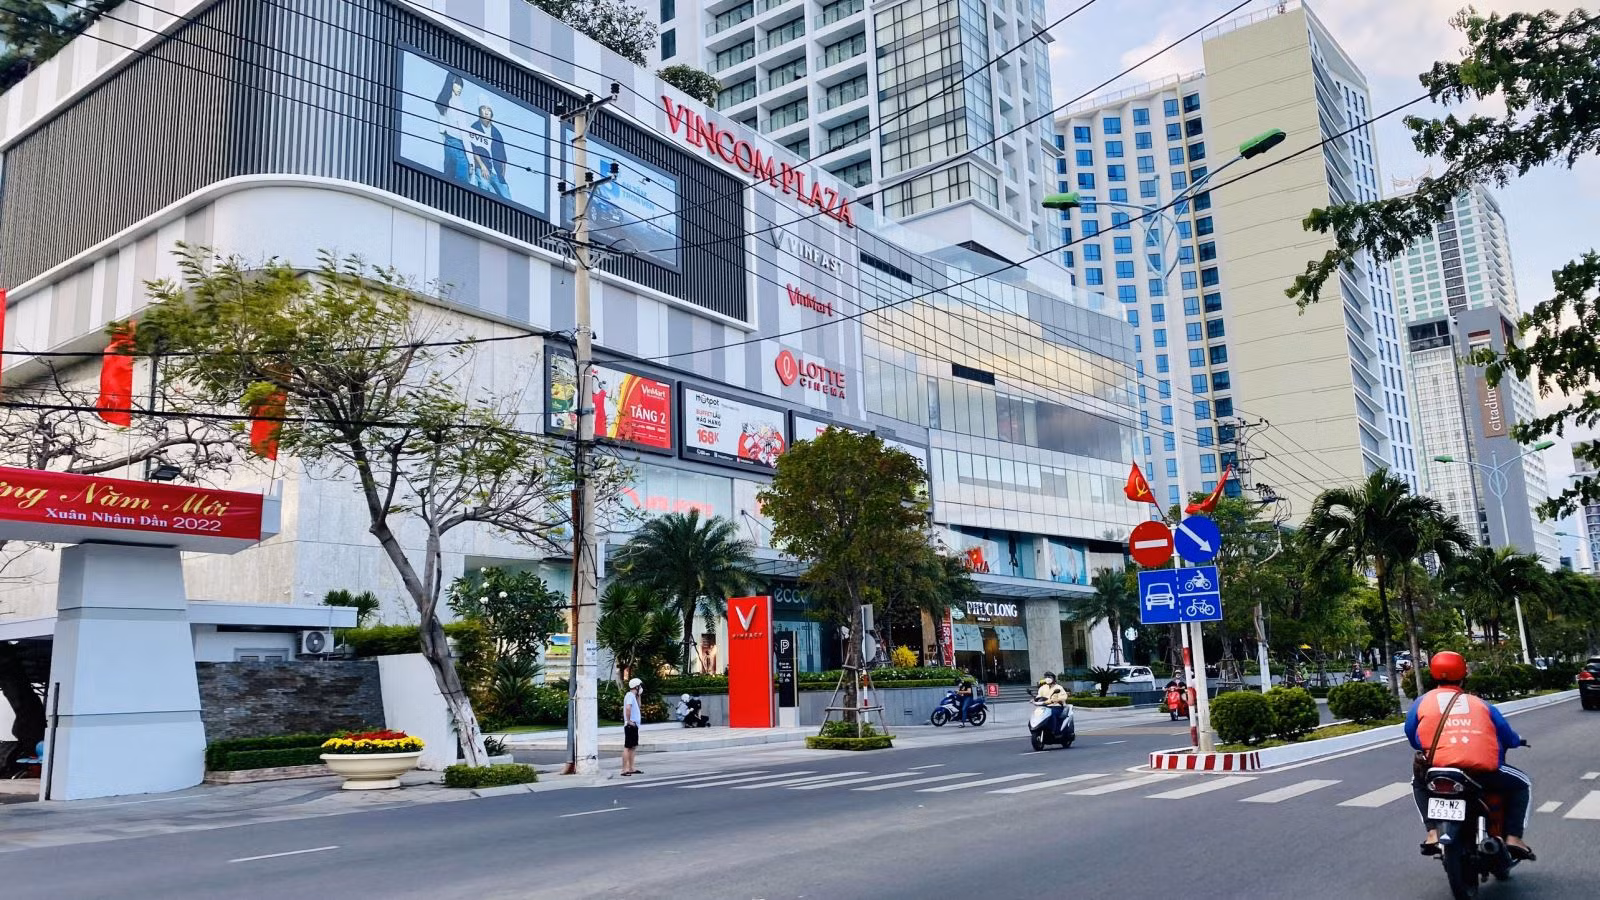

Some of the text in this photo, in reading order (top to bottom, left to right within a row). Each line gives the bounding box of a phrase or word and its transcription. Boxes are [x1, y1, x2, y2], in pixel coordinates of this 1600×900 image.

[661, 95, 855, 228] VINCOM PLAZA
[788, 236, 844, 275] VINFAST
[787, 283, 833, 316] VinMart
[799, 359, 845, 388] LOTTE
[800, 378, 845, 399] CINEMA
[660, 412, 666, 424] 2
[60, 482, 151, 511] Năm
[162, 493, 230, 517] Mới
[45, 507, 221, 532] Xuân Nhâm Dần 2022
[993, 603, 1018, 618] LONG
[781, 640, 789, 653] P
